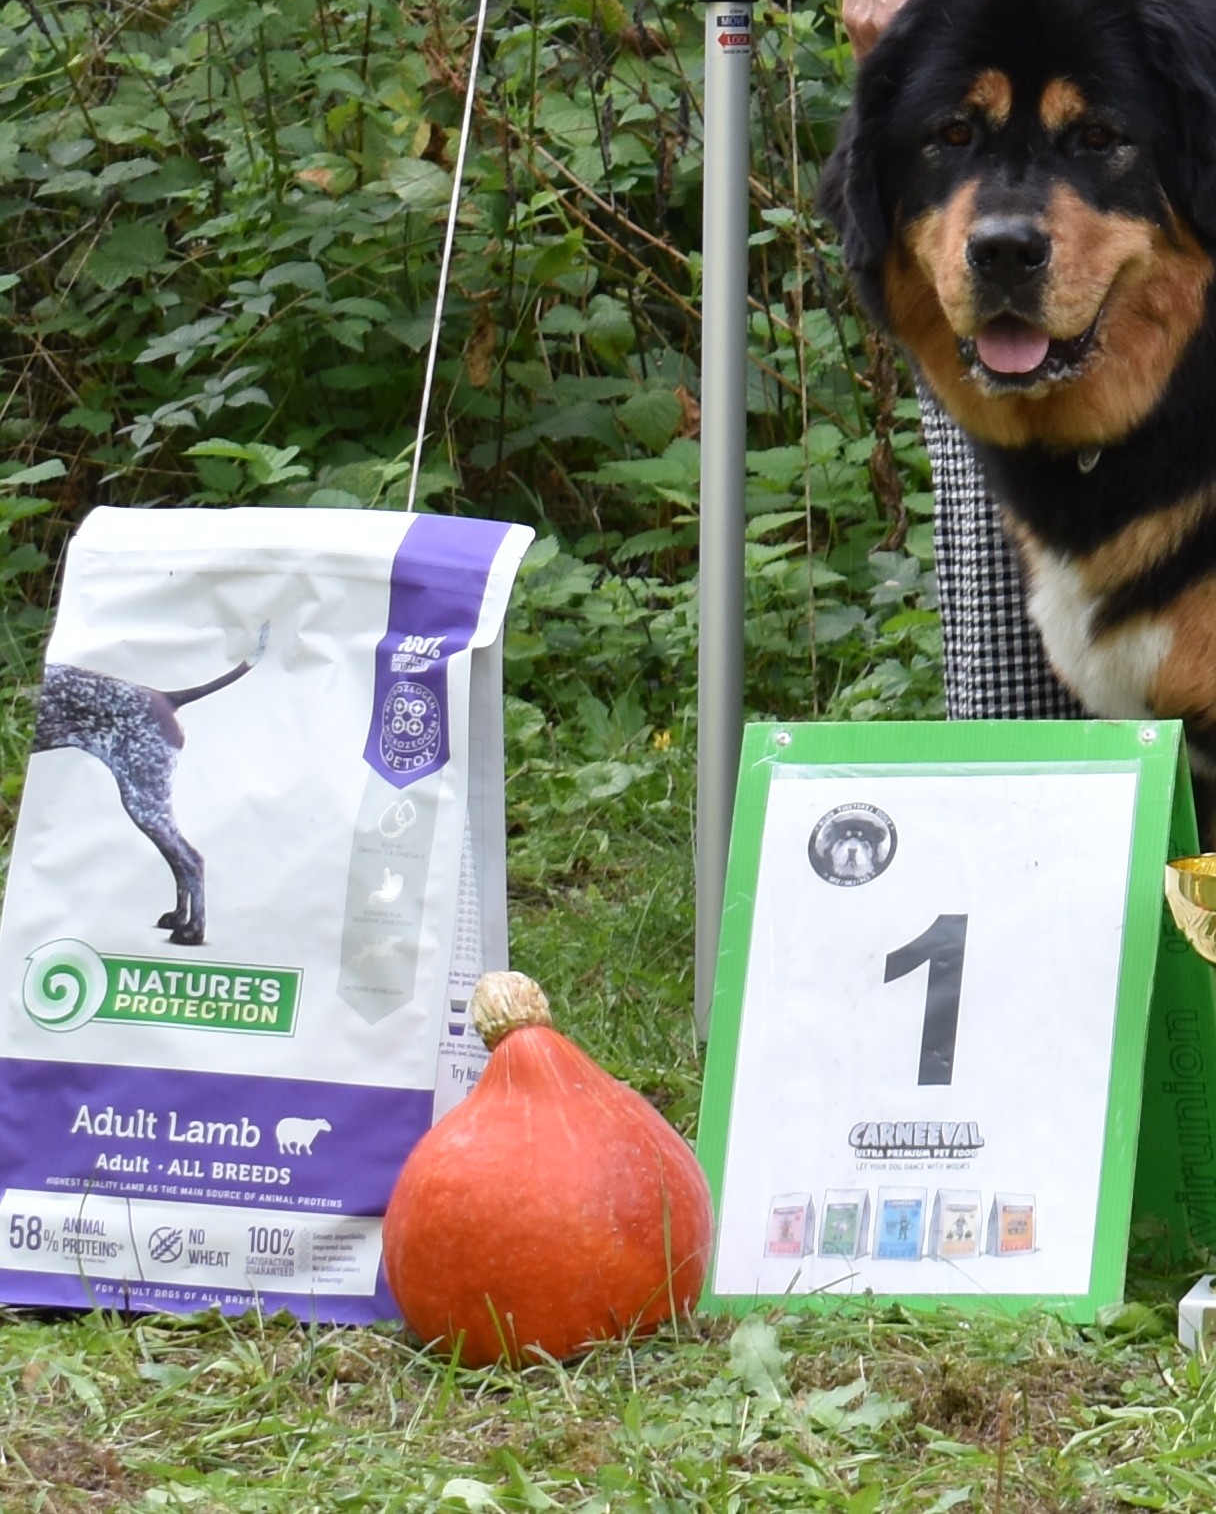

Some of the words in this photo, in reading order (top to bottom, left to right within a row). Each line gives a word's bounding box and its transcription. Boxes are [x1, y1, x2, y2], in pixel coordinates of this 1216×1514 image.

[385, 747, 434, 770] DETOX
[116, 966, 281, 1004] NATURE'S
[113, 993, 279, 1024] PROTECTION
[882, 912, 970, 1087] 1
[451, 1064, 465, 1084] Try
[71, 1104, 158, 1141] Adult
[168, 1111, 262, 1148] Lamb
[848, 1121, 985, 1148] CARNEEVAL
[95, 1152, 150, 1174] Adult
[166, 1159, 206, 1179] ALL
[211, 1162, 292, 1186] BREEDS
[119, 1181, 145, 1192] LAMB
[146, 1183, 158, 1193] AS
[161, 1184, 178, 1195] THE
[180, 1186, 203, 1197] MAIN
[206, 1188, 242, 1201] SOURCE
[244, 1191, 256, 1201] OF
[258, 1193, 294, 1205] ANIMAL
[297, 1196, 343, 1208] PROTEINS
[9, 1213, 59, 1253] 58%
[62, 1217, 108, 1237] ANIMAL
[188, 1228, 206, 1245] NO
[247, 1226, 295, 1256] 100%
[187, 1249, 231, 1268] WHEAT
[245, 1255, 295, 1267] SATISFACTION
[245, 1266, 295, 1278] GUARANTEED
[95, 1283, 114, 1293] FOR
[154, 1288, 180, 1299] DOGS
[184, 1290, 197, 1300] OF
[201, 1293, 220, 1303] ALL
